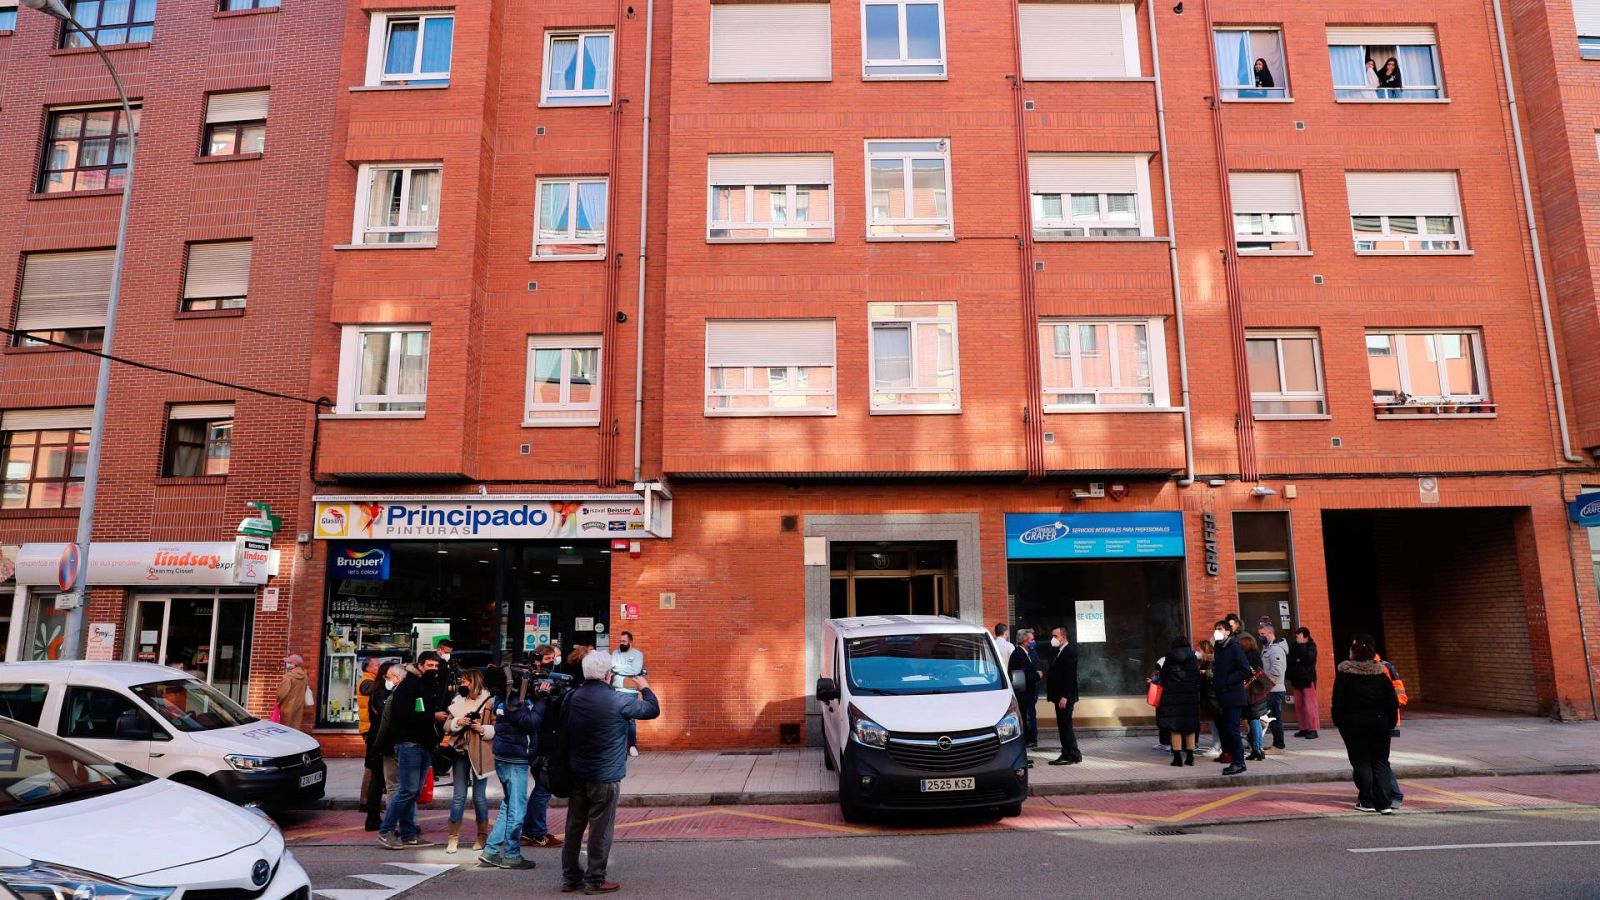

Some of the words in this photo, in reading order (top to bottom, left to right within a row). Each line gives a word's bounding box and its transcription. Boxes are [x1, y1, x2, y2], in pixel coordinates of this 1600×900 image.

[387, 504, 547, 534] Principado
[386, 526, 471, 535] PINTURAS
[1024, 531, 1057, 541] GRAFER
[1203, 512, 1220, 576] GRAFER
[215, 562, 234, 572] expr
[337, 556, 380, 568] Bruguer
[166, 568, 175, 576] my
[1077, 612, 1085, 620] SE
[1085, 612, 1104, 620] VENDE
[927, 780, 952, 790] 2525
[954, 778, 973, 789] KSZ
